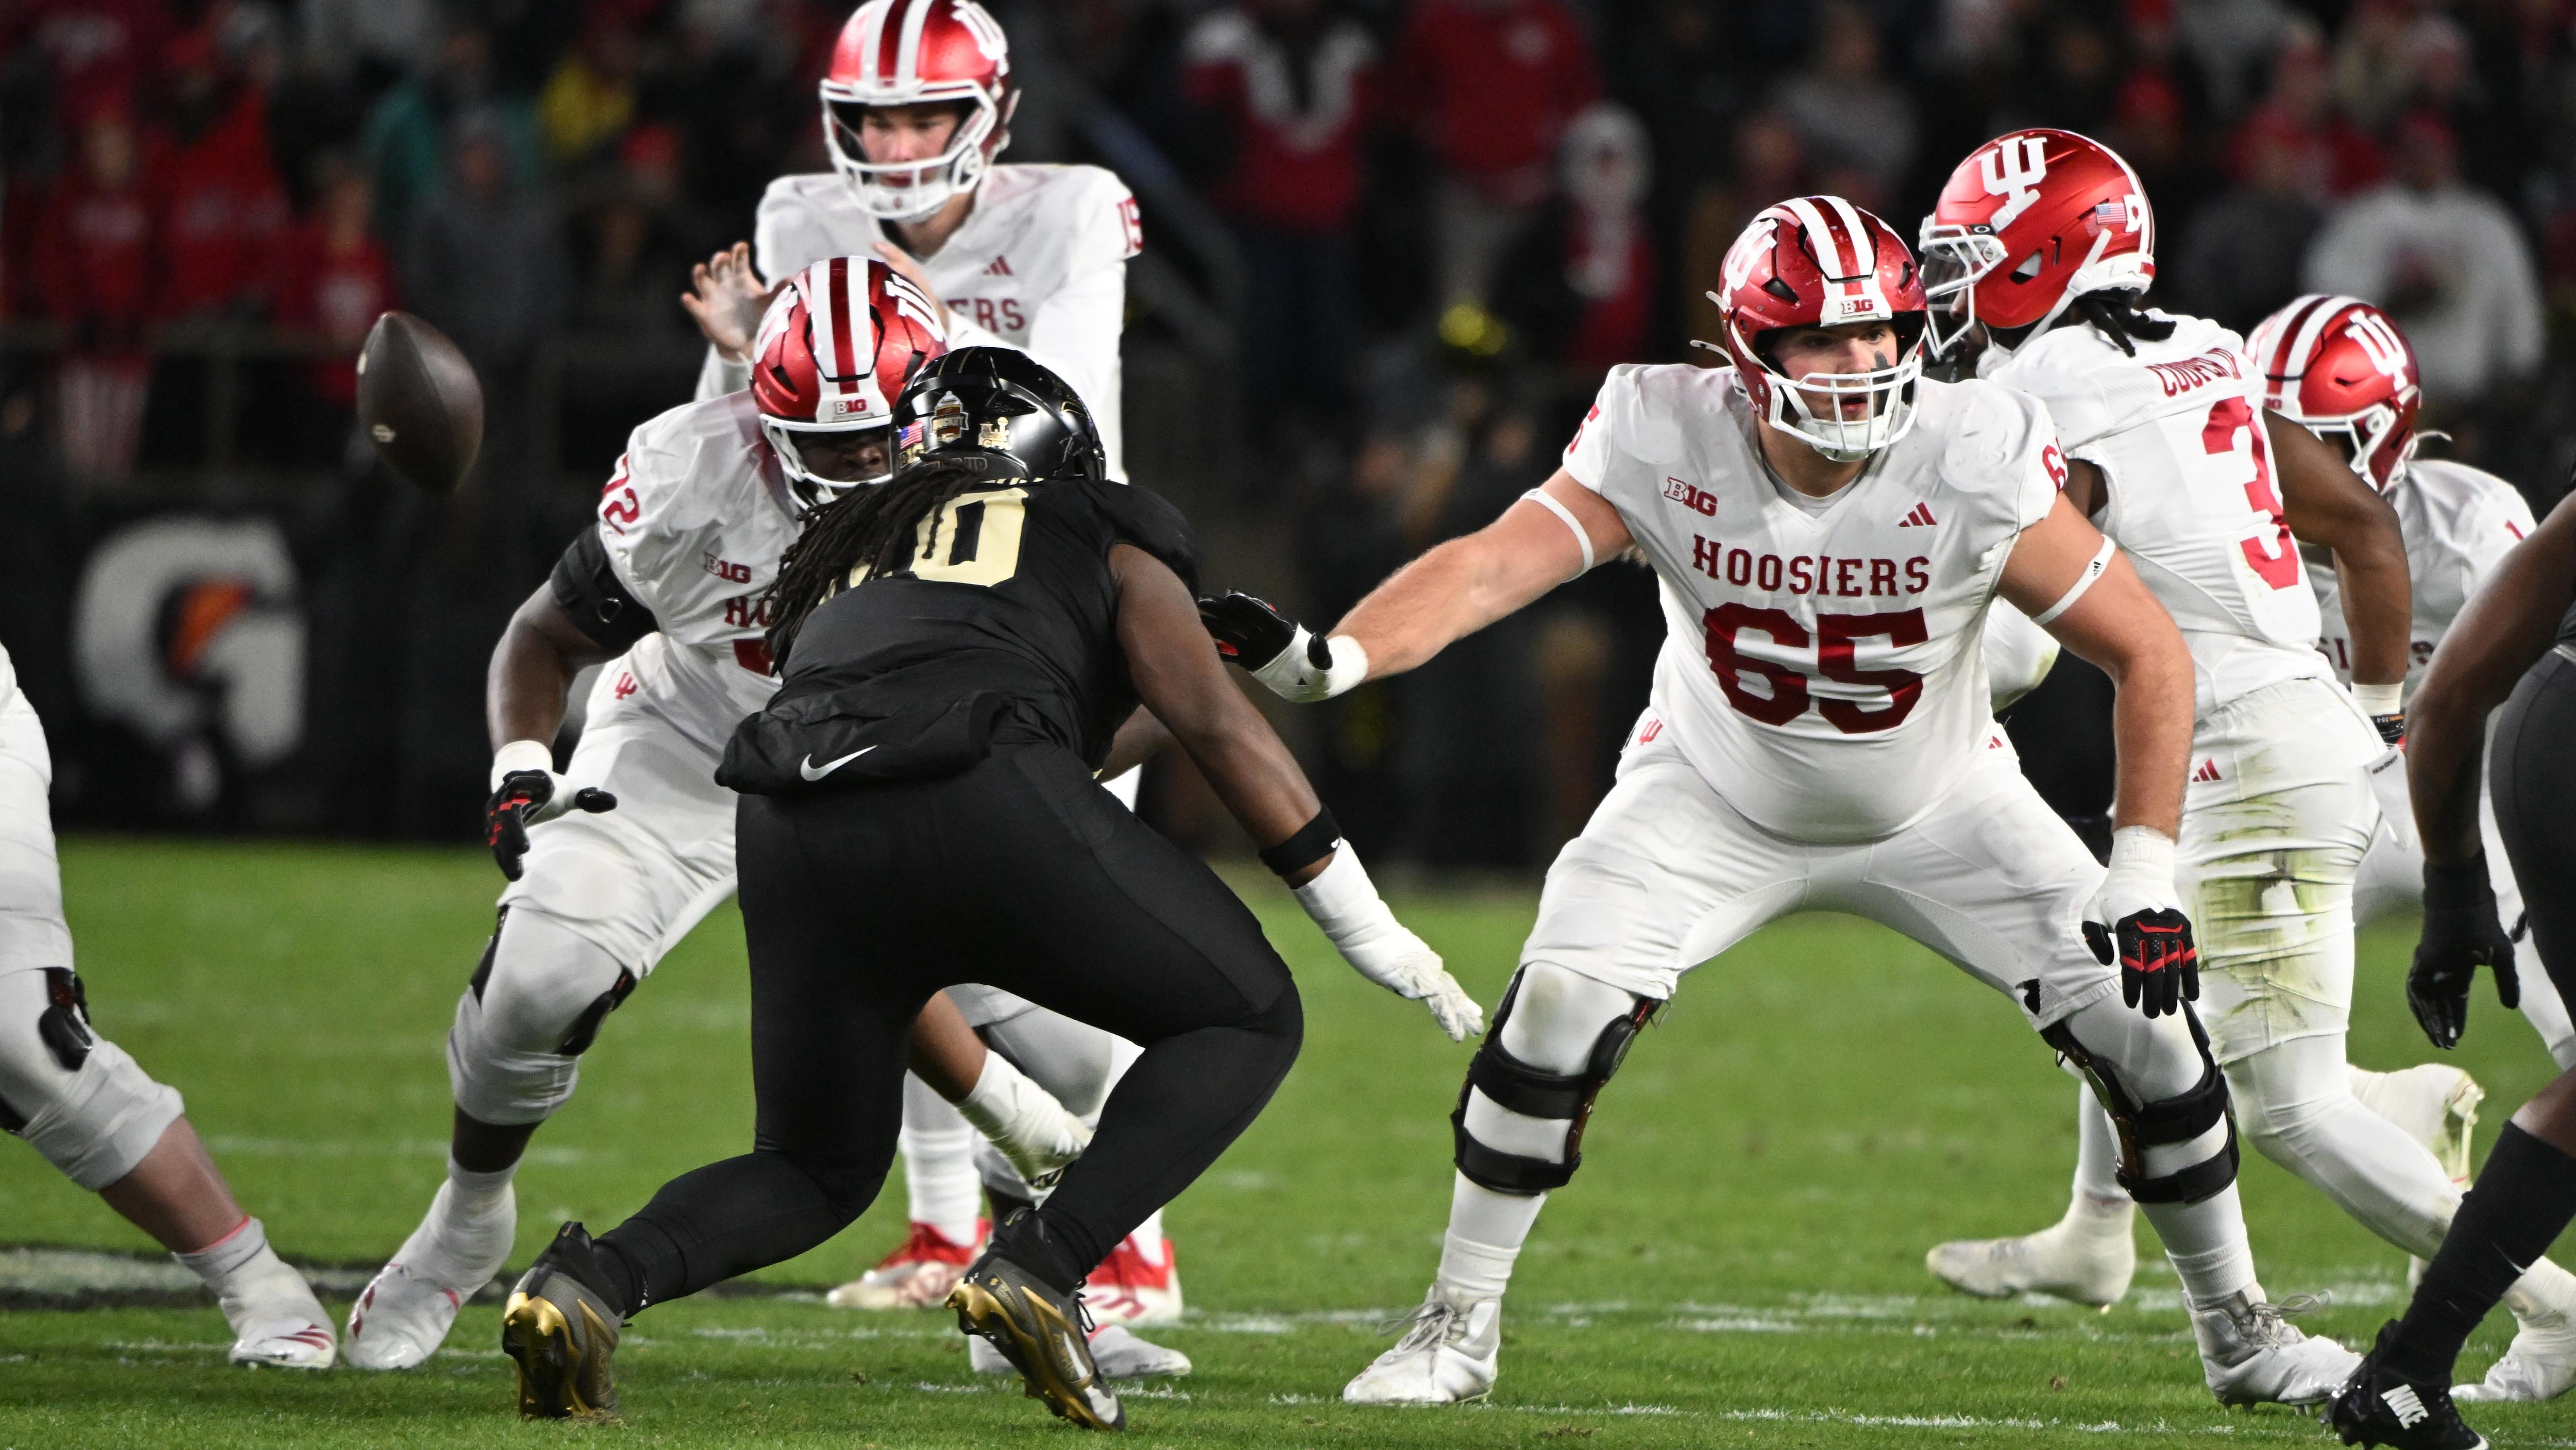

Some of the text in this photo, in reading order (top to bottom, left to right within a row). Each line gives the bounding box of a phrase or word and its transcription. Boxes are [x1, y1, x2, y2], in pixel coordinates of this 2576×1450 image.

[2201, 395, 2299, 591] 3
[1692, 533, 1930, 597] HOOSIERS
[1702, 601, 1928, 734] 65
[2380, 1384, 2429, 1430] NIKE
